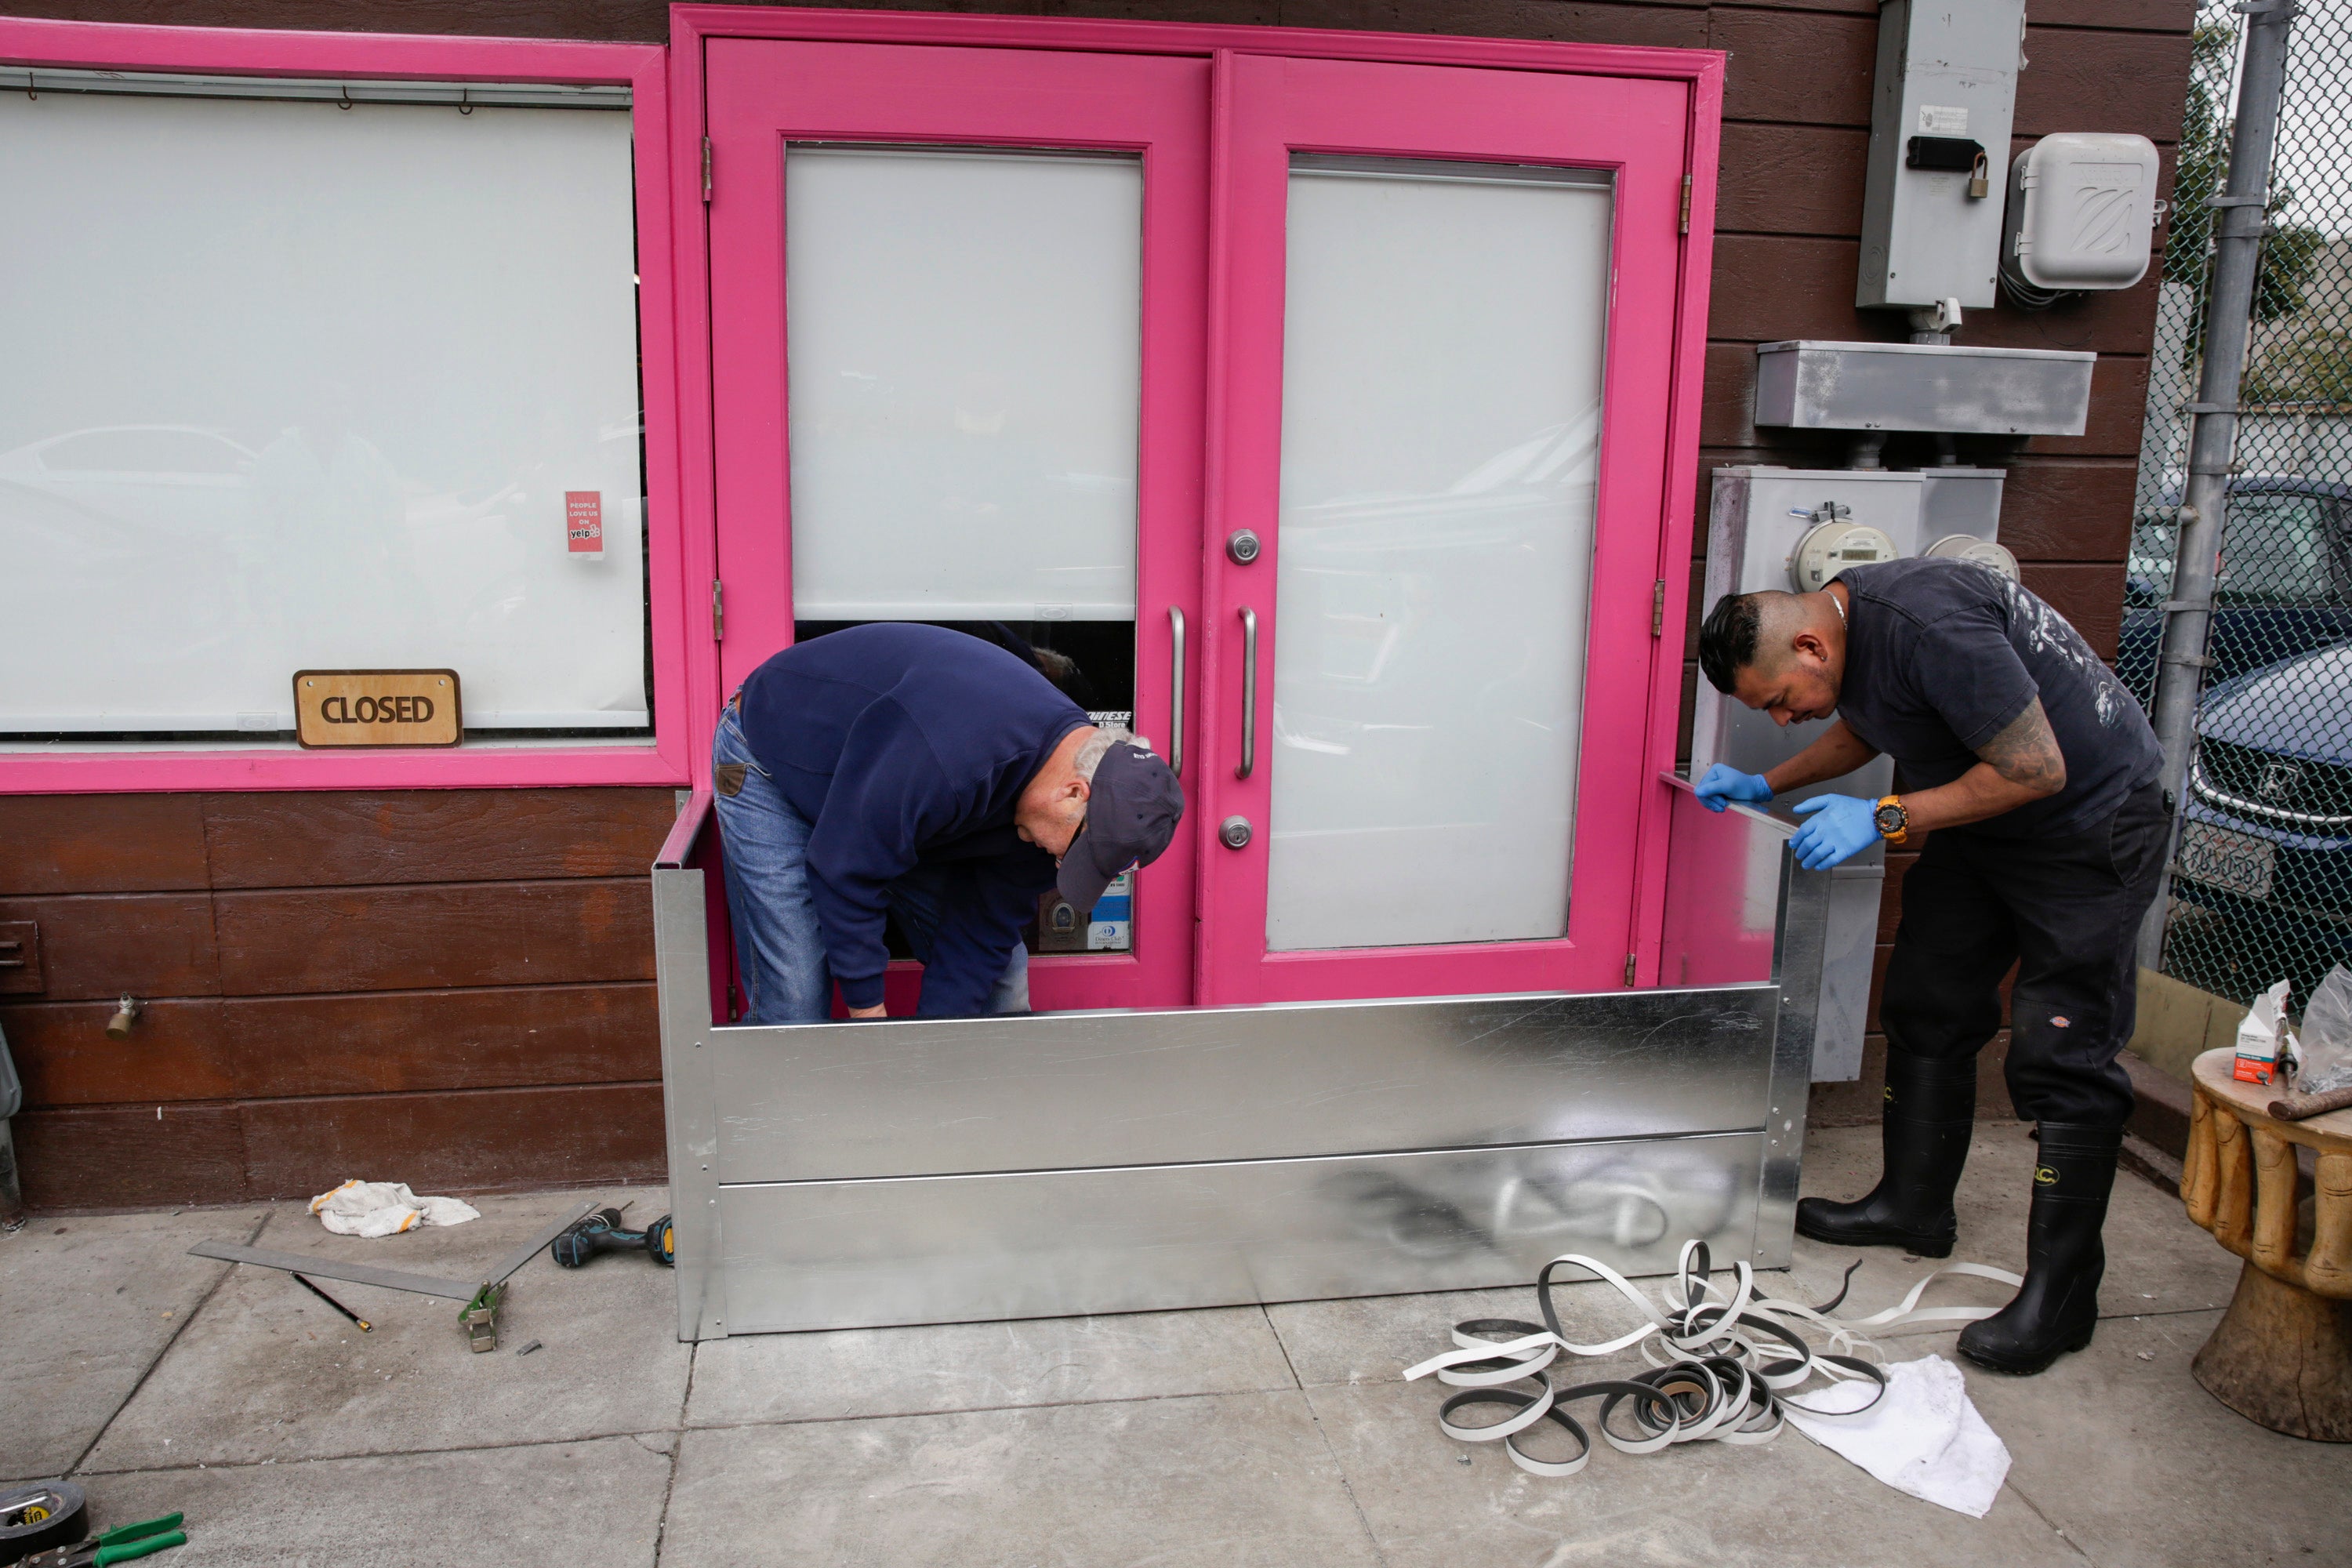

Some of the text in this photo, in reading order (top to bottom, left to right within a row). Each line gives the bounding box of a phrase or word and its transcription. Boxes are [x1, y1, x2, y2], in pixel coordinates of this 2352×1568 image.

[571, 528, 590, 539] yelp
[321, 695, 435, 724] CLOSED
[1087, 711, 1132, 720] AINESE
